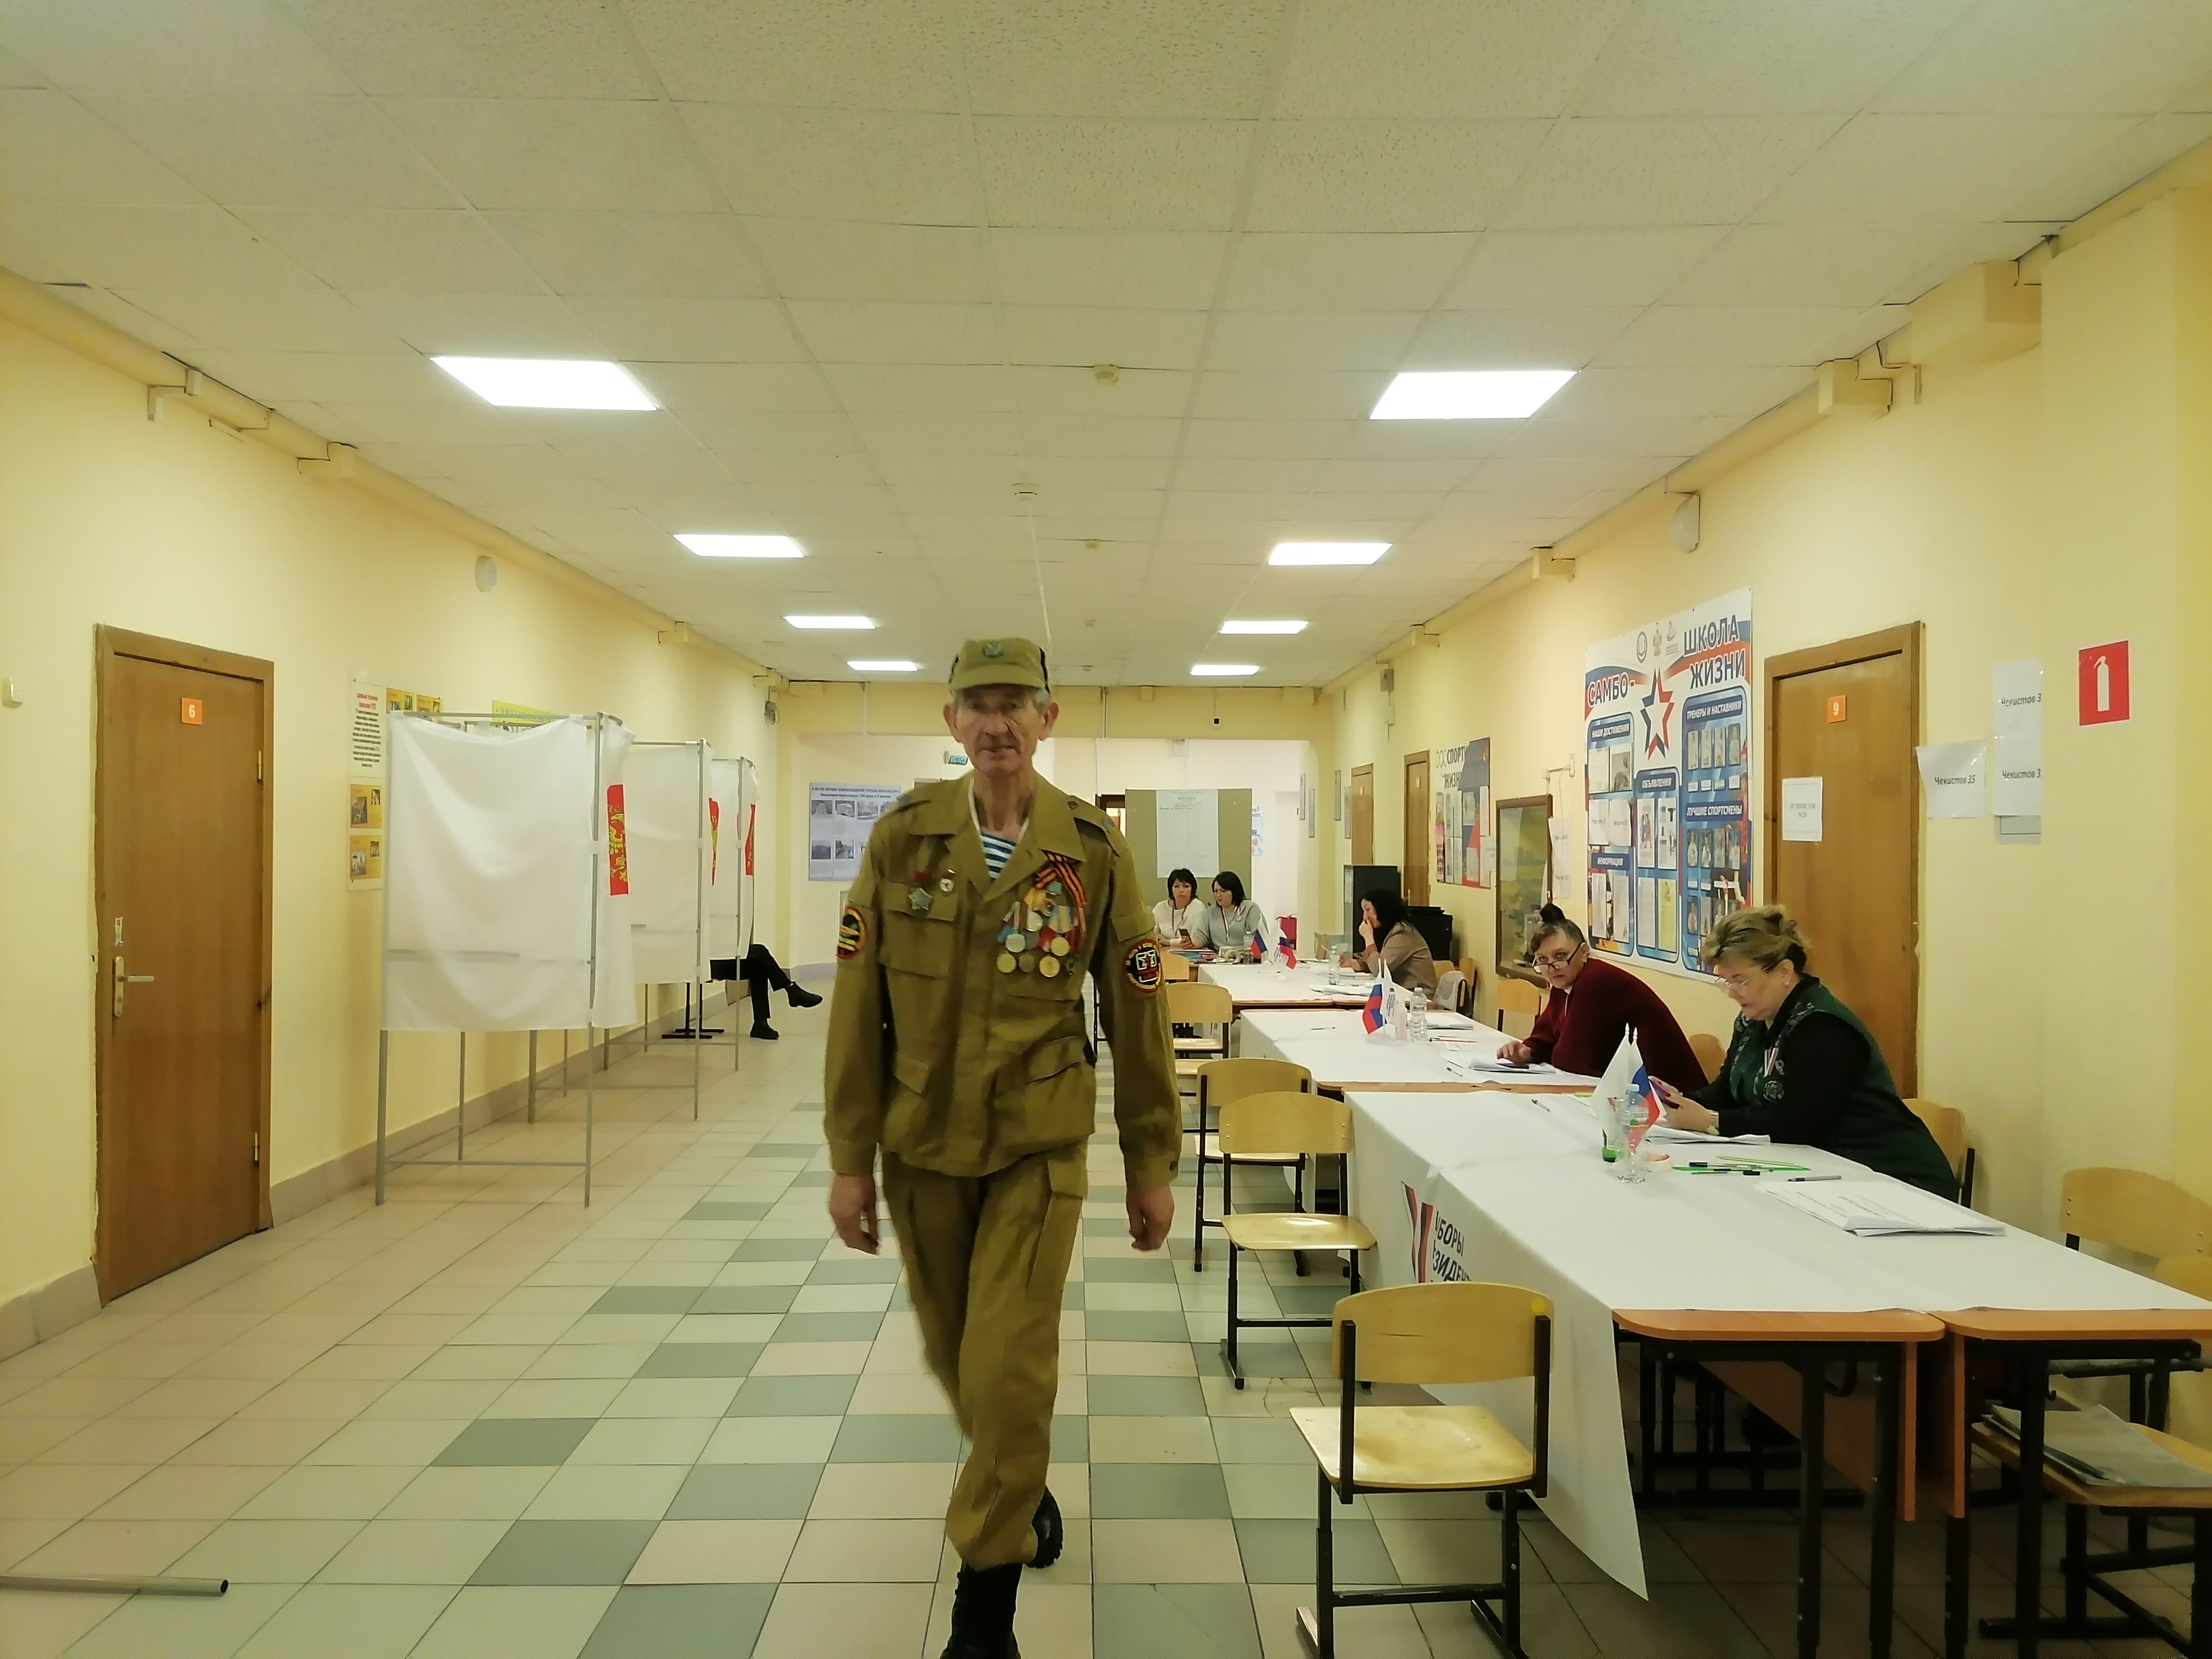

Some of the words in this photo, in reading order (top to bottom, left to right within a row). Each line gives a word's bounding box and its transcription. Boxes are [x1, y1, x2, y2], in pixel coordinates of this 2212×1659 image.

[1683, 614, 1739, 656] ШКОЛА
[1689, 649, 1745, 690] ЖИЗНИ
[1588, 673, 1635, 706] САМБО-
[189, 704, 196, 718] 6
[1687, 707, 1707, 720] ТРЕНЕРЫ
[1707, 707, 1712, 716] И
[1711, 700, 1742, 715] НАСТАВНИКИ
[1833, 702, 1839, 716] 9
[1934, 776, 1967, 785] Чекистов
[1968, 774, 1976, 784] 35
[2002, 770, 2036, 779] Чекистов
[1642, 778, 1672, 789] ОБЪЯВЛЕНИЯ
[1686, 806, 1708, 816] ЛУЧШИЕ
[1707, 805, 1743, 816] СПОРТСМЕНЫ
[1597, 857, 1624, 867] ИНФОРМАЦИЯ
